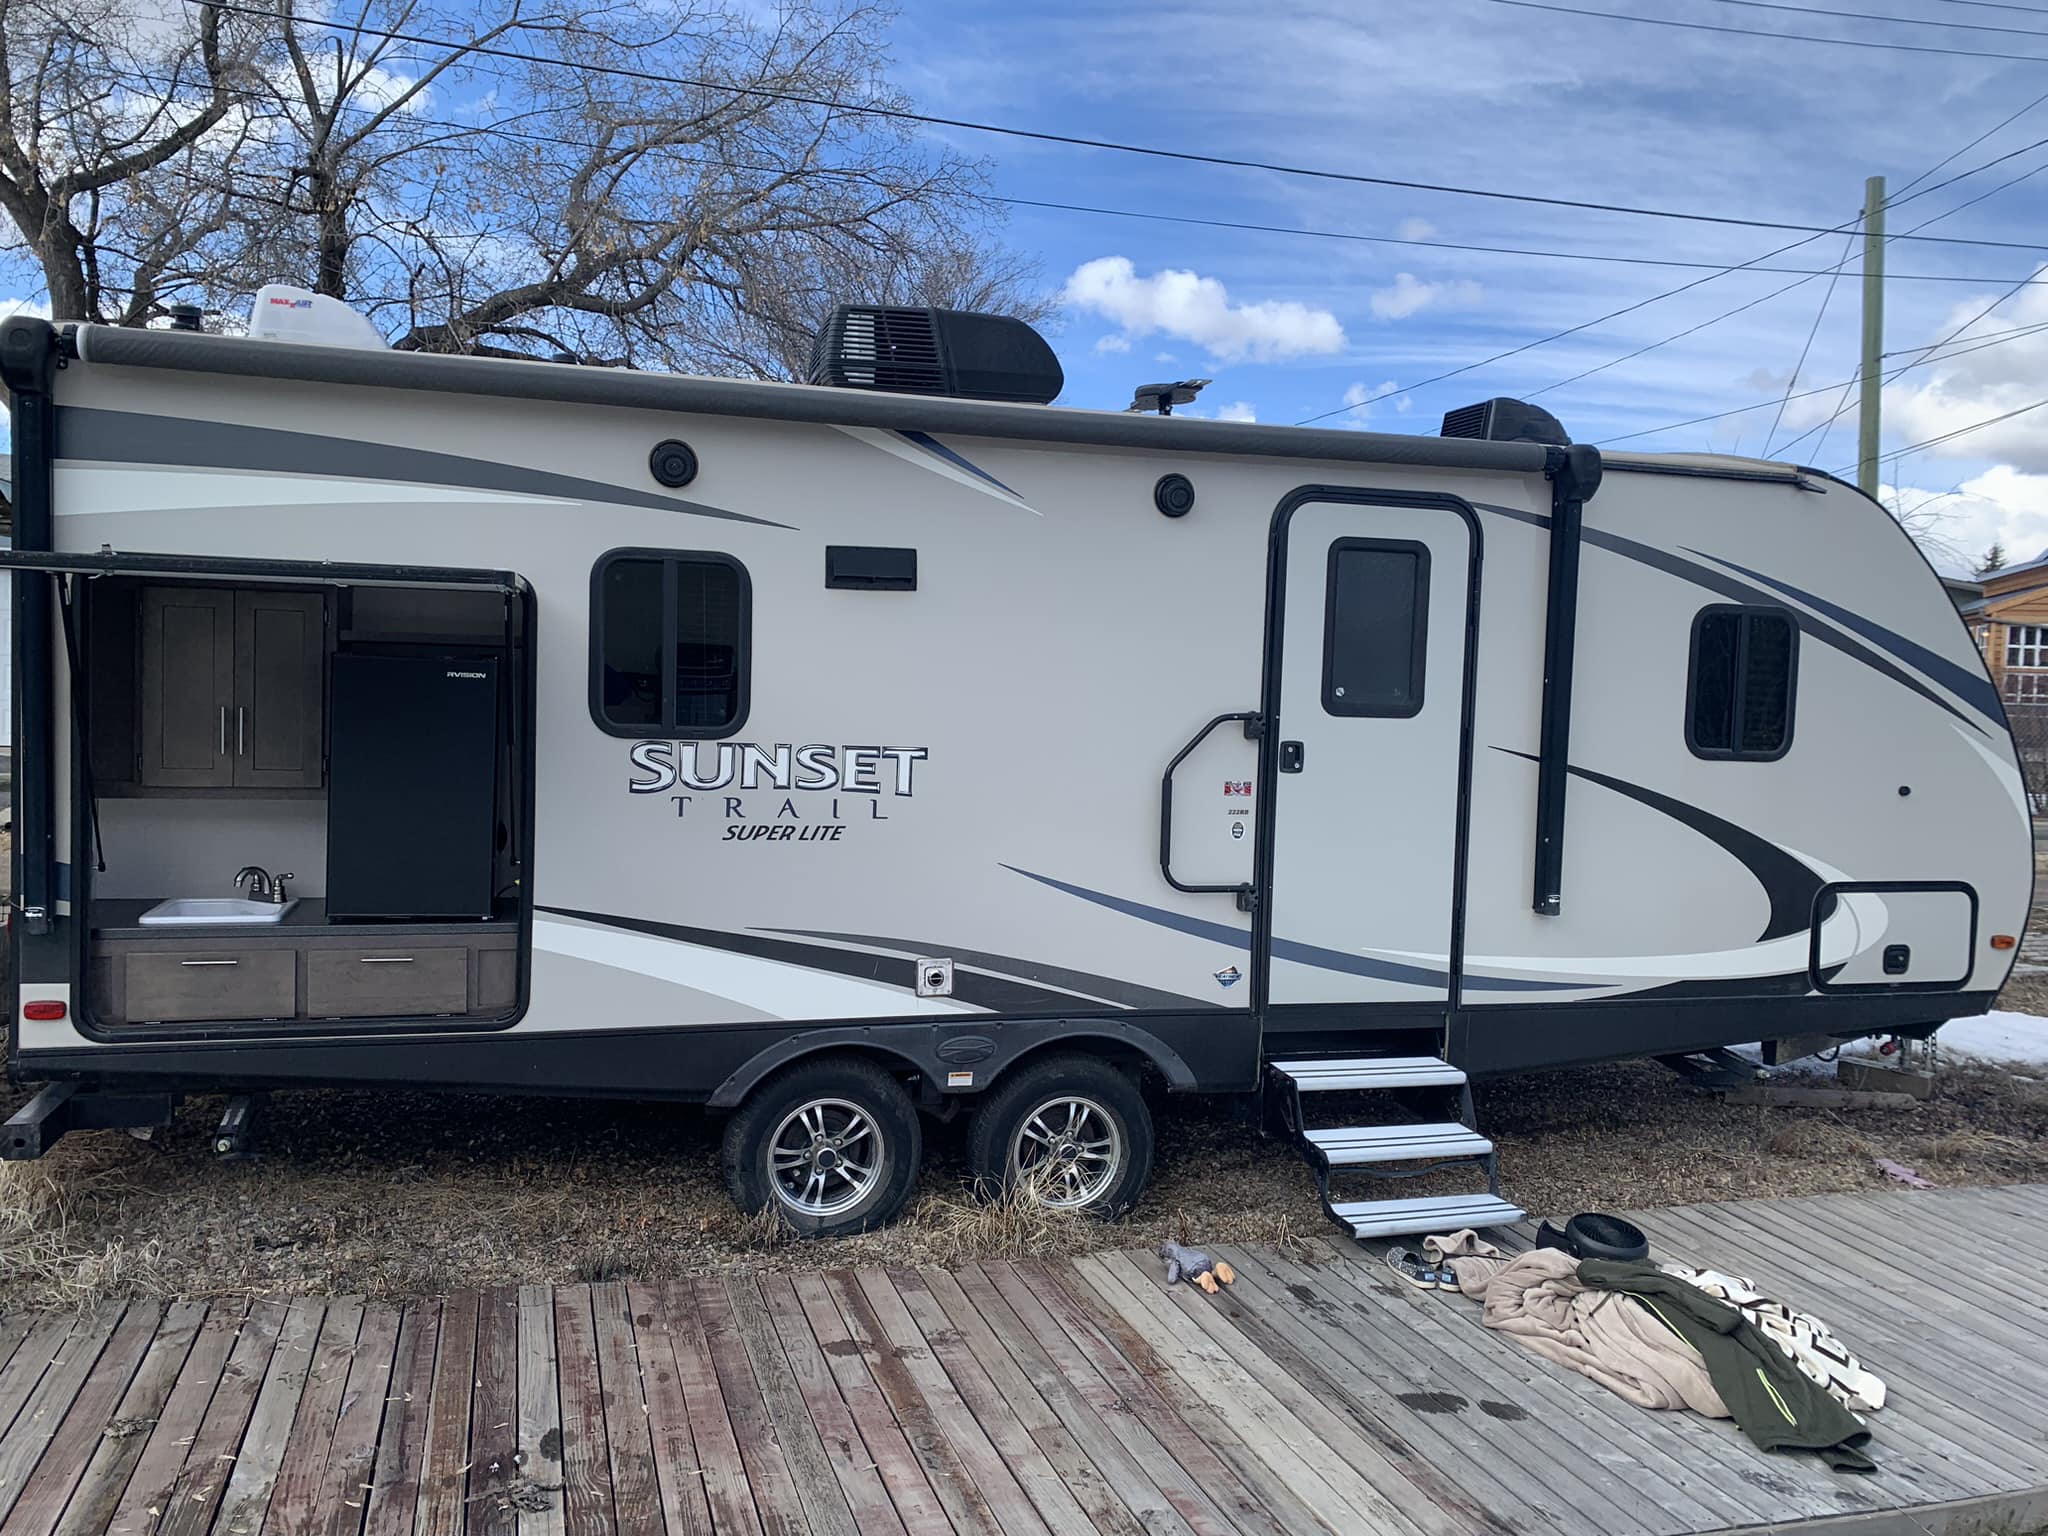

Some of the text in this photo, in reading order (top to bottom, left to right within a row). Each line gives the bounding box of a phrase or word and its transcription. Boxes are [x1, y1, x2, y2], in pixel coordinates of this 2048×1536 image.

[629, 740, 929, 797] SUNSET
[671, 796, 888, 820] TRAIL
[722, 825, 847, 841] SUPER LITE
